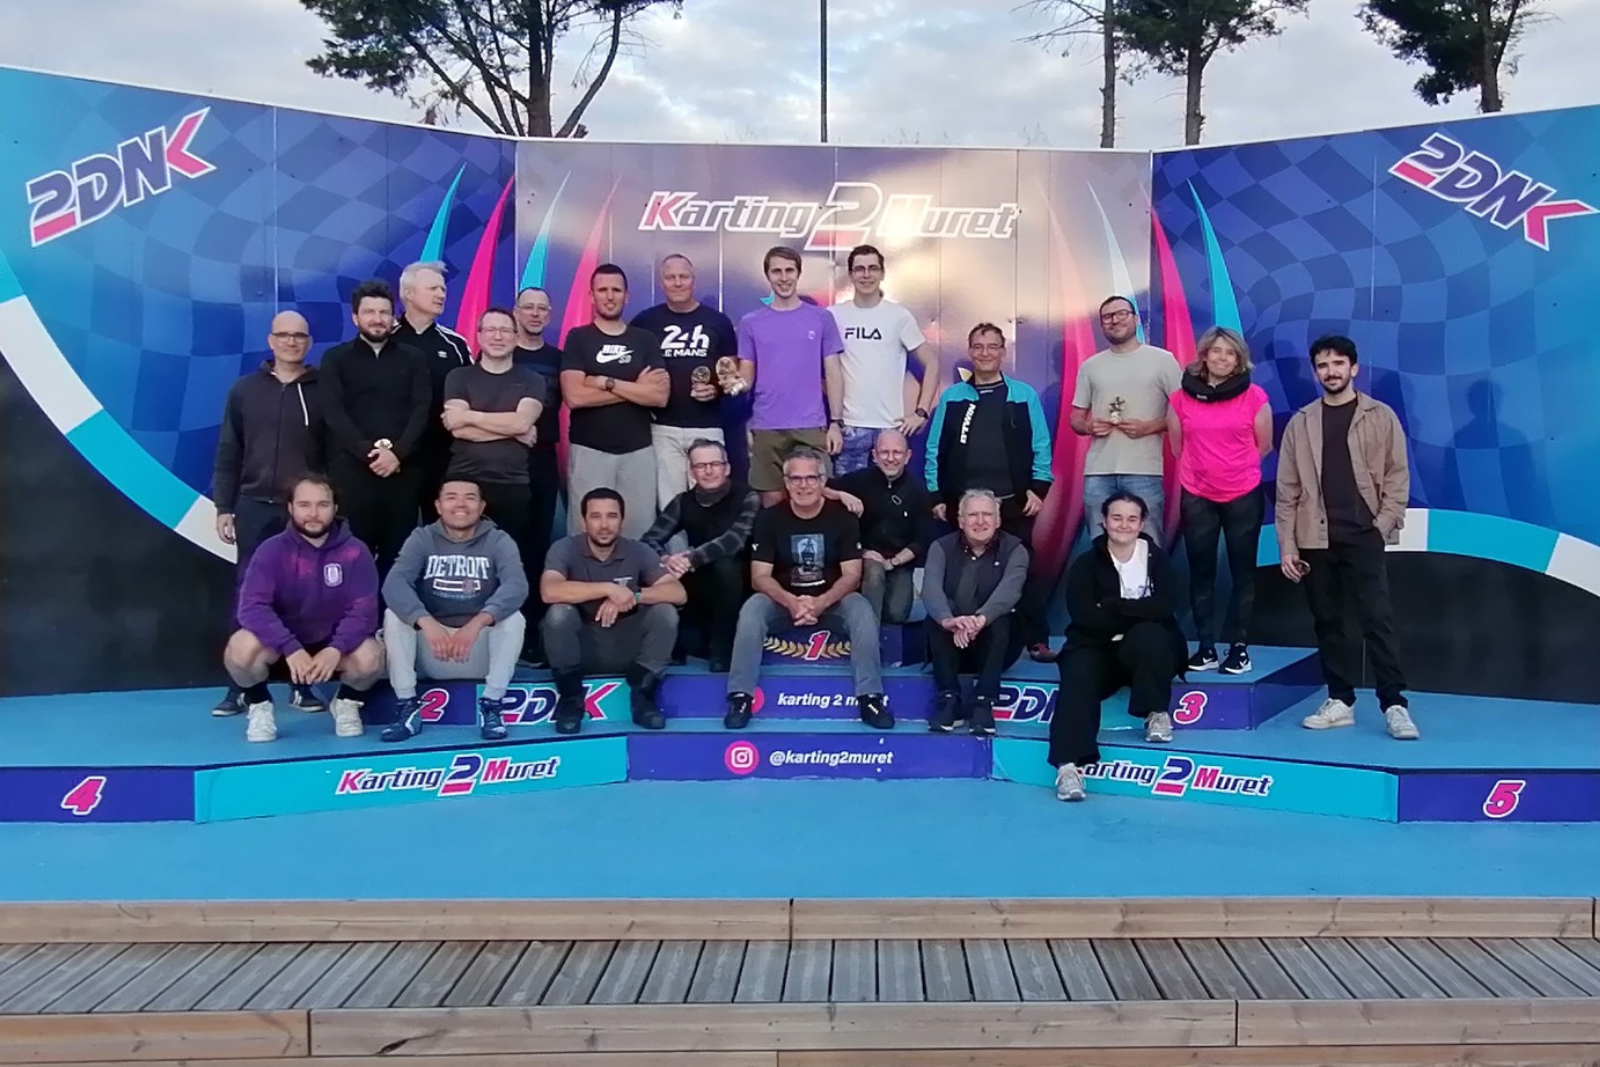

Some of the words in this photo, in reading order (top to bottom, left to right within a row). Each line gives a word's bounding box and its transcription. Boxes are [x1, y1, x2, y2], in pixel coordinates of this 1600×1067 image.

[26, 107, 217, 248] 2DNK
[1388, 132, 1600, 251] 2DNK
[638, 191, 818, 238] Karting
[804, 182, 883, 251] 2
[876, 194, 1019, 238] Muret
[602, 344, 627, 355] NIKE
[845, 327, 882, 340] FILA
[673, 349, 707, 357] MANS
[423, 554, 490, 580] DETROIT
[804, 630, 831, 661] 1
[421, 688, 449, 722] 2
[499, 682, 622, 726] 2DK
[777, 692, 830, 709] karting
[833, 694, 843, 706] 2
[1174, 691, 1207, 725] 3
[335, 766, 445, 796] Karting
[437, 753, 482, 796] 2
[479, 756, 561, 785] Muret
[769, 750, 893, 767] @karting2muret
[1076, 759, 1160, 787] arting
[1151, 756, 1196, 797] 2
[1190, 764, 1275, 797] Muret
[61, 776, 107, 816] 4
[1482, 779, 1526, 818] 5
